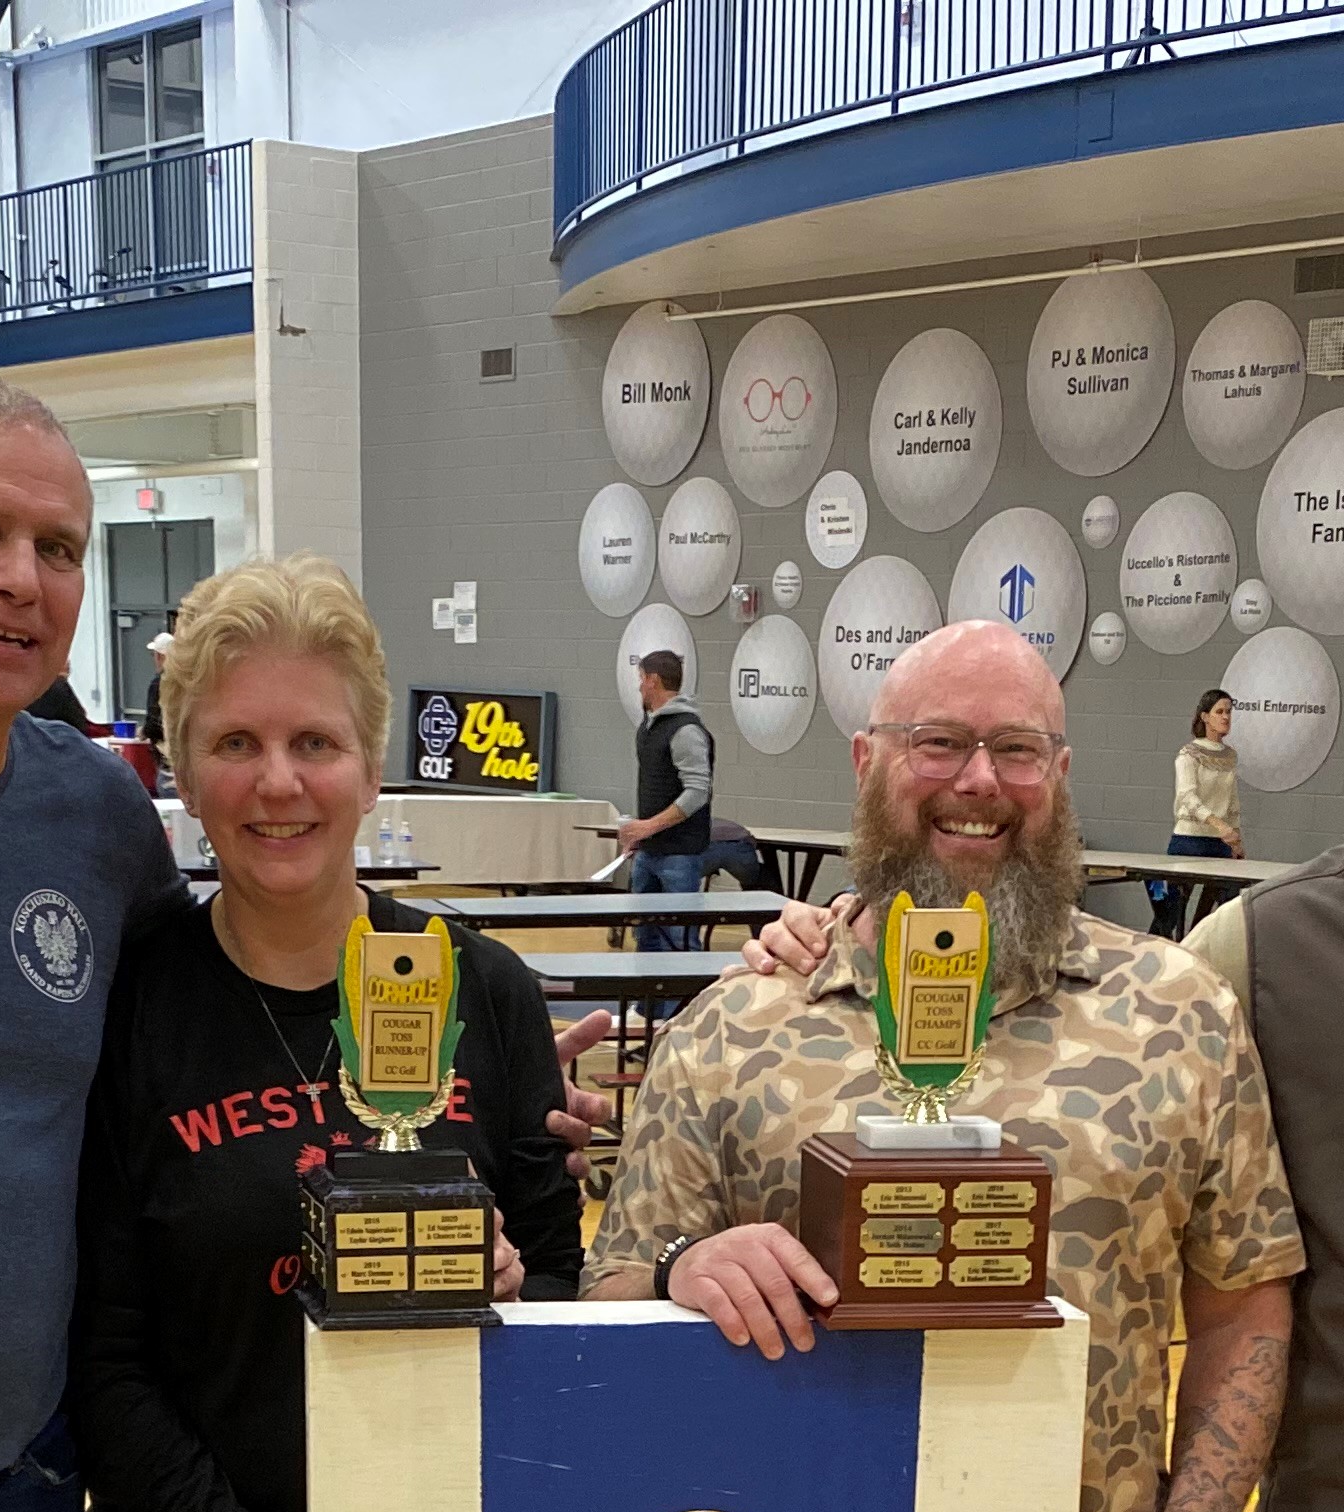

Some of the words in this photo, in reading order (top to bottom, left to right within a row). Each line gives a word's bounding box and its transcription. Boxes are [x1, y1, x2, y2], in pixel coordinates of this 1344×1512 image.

[1051, 350, 1073, 369] PJ
[1076, 348, 1087, 366] &
[1091, 344, 1148, 365] Monica
[1191, 366, 1235, 382] Thomas
[1238, 365, 1247, 378] &
[1249, 361, 1300, 379] Margaret
[621, 382, 646, 404] Bill
[650, 380, 692, 403] Monk
[1067, 374, 1129, 396] Sullivan
[1224, 383, 1262, 399] Lahuis
[894, 411, 922, 430] Carl
[926, 409, 937, 427] &
[940, 406, 976, 429] Kelly
[897, 435, 971, 457] Jandernoa
[1294, 492, 1330, 512] The
[669, 533, 688, 545] Paul
[689, 531, 731, 546] McCarthy
[603, 554, 632, 565] Warner
[1127, 555, 1174, 571] Uccello's
[1176, 551, 1231, 567] Ristorante
[1173, 573, 1182, 587] &
[1125, 594, 1144, 608] The
[1146, 593, 1192, 607] Piccione
[1194, 590, 1231, 607] Family
[835, 625, 861, 643] Des
[866, 626, 892, 643] and
[761, 686, 789, 697] MOLL
[792, 686, 808, 697] CO.
[1264, 699, 1326, 716] Enterprises
[459, 701, 525, 754] 19th
[419, 756, 453, 780] GOLF
[480, 746, 540, 782] hole
[915, 992, 965, 1003] COUGAR
[925, 1006, 954, 1017] TOSS
[382, 1018, 422, 1030] COUGAR
[914, 1019, 962, 1030] CHAMPS
[390, 1032, 414, 1043] TOSS
[917, 1039, 932, 1050] CC
[935, 1038, 957, 1050] Golf
[375, 1045, 428, 1057] RUNNER-UP
[385, 1065, 399, 1076] CC
[400, 1064, 417, 1077] Golf
[169, 1078, 473, 1153] WESTE
